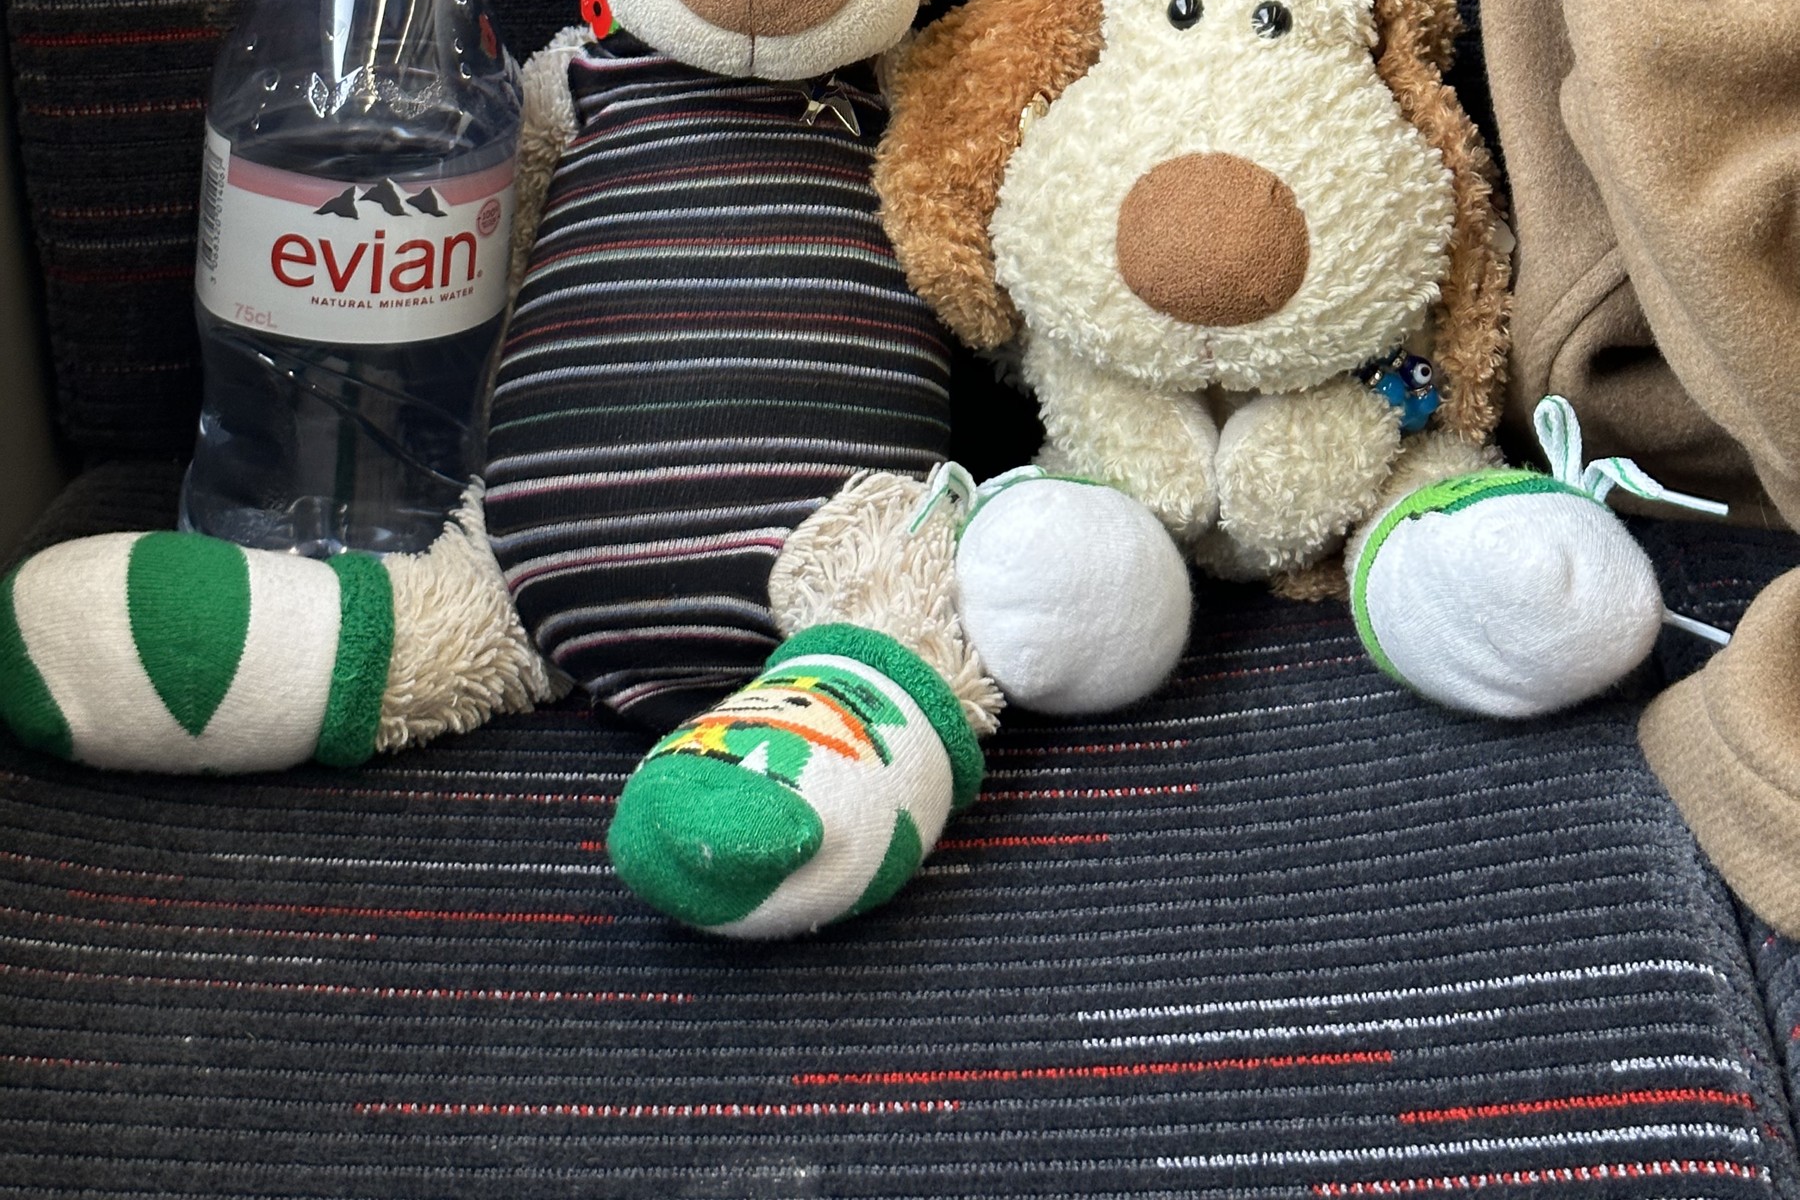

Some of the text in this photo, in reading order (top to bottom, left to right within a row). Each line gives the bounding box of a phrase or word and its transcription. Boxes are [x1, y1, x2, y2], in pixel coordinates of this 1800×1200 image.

[271, 230, 477, 293] evian
[311, 286, 474, 309] NATURAL MINERAL WATER
